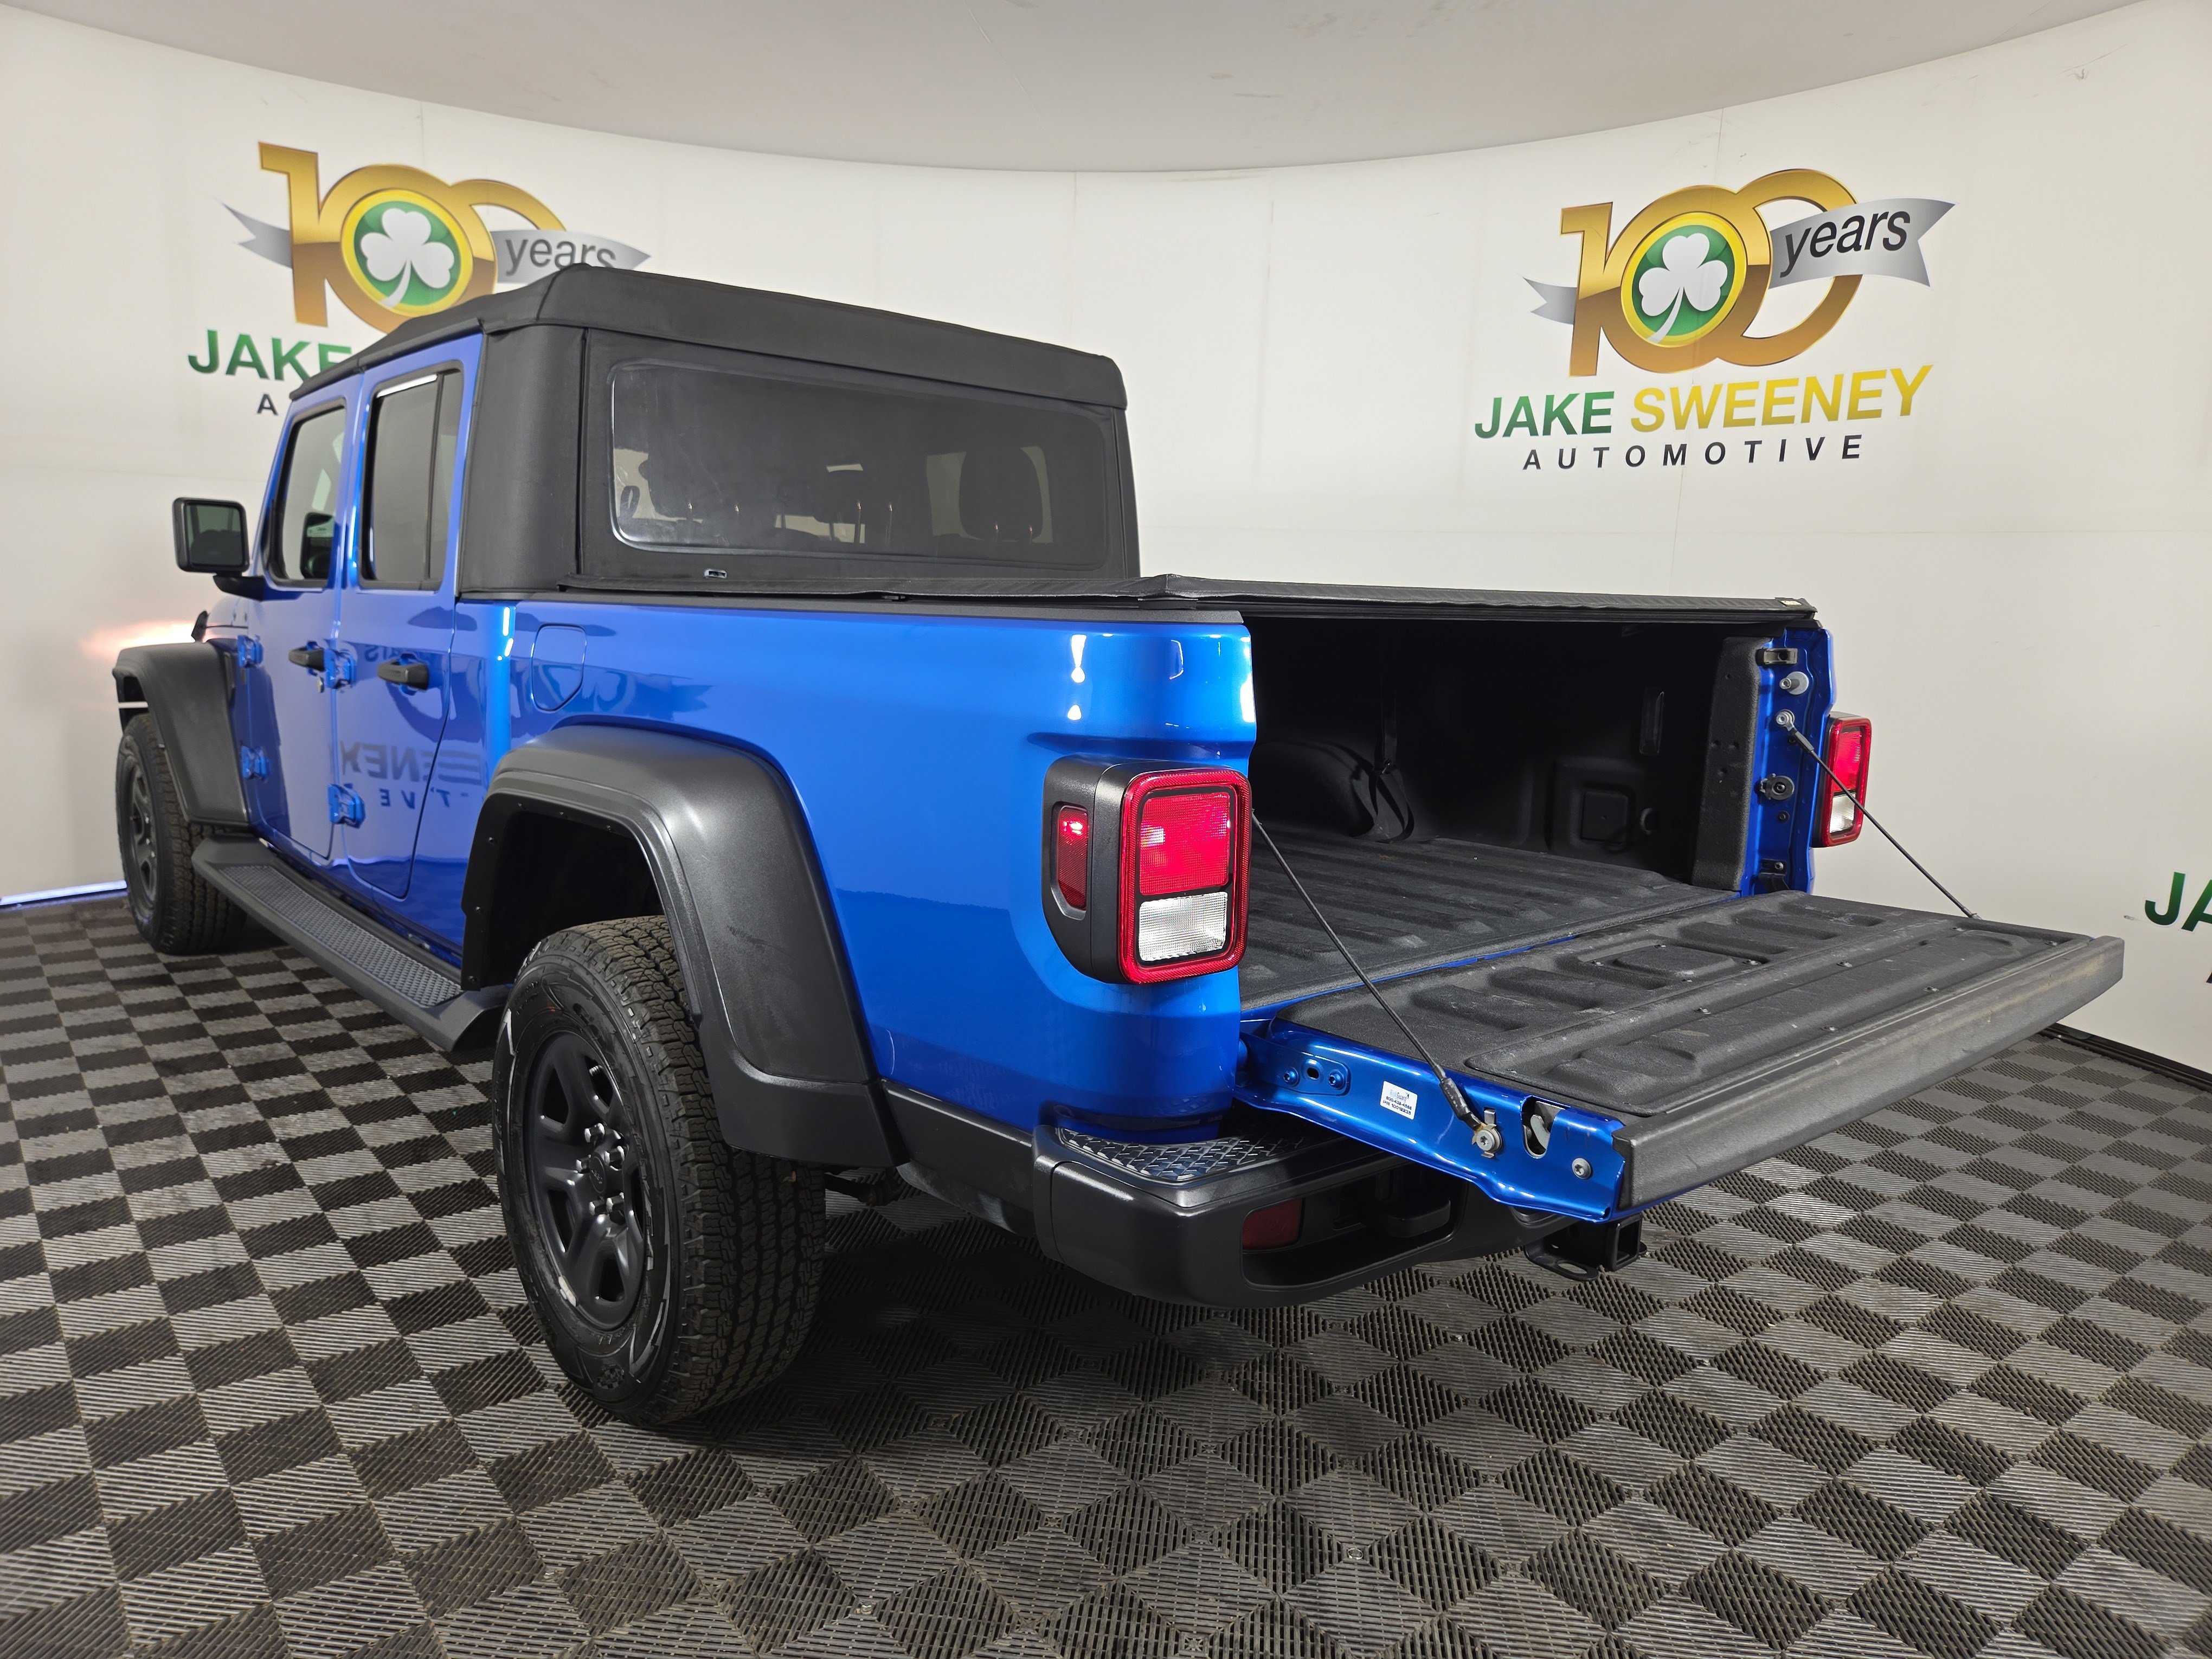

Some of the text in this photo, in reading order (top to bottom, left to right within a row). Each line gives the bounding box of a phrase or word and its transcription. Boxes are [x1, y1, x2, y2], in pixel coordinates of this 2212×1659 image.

[505, 239, 616, 276] years
[1560, 168, 1863, 378] 100
[1779, 210, 1911, 278] years
[1474, 364, 1934, 439] JAKE SWEENEY
[1522, 434, 1863, 471] AUTOMOTIVE
